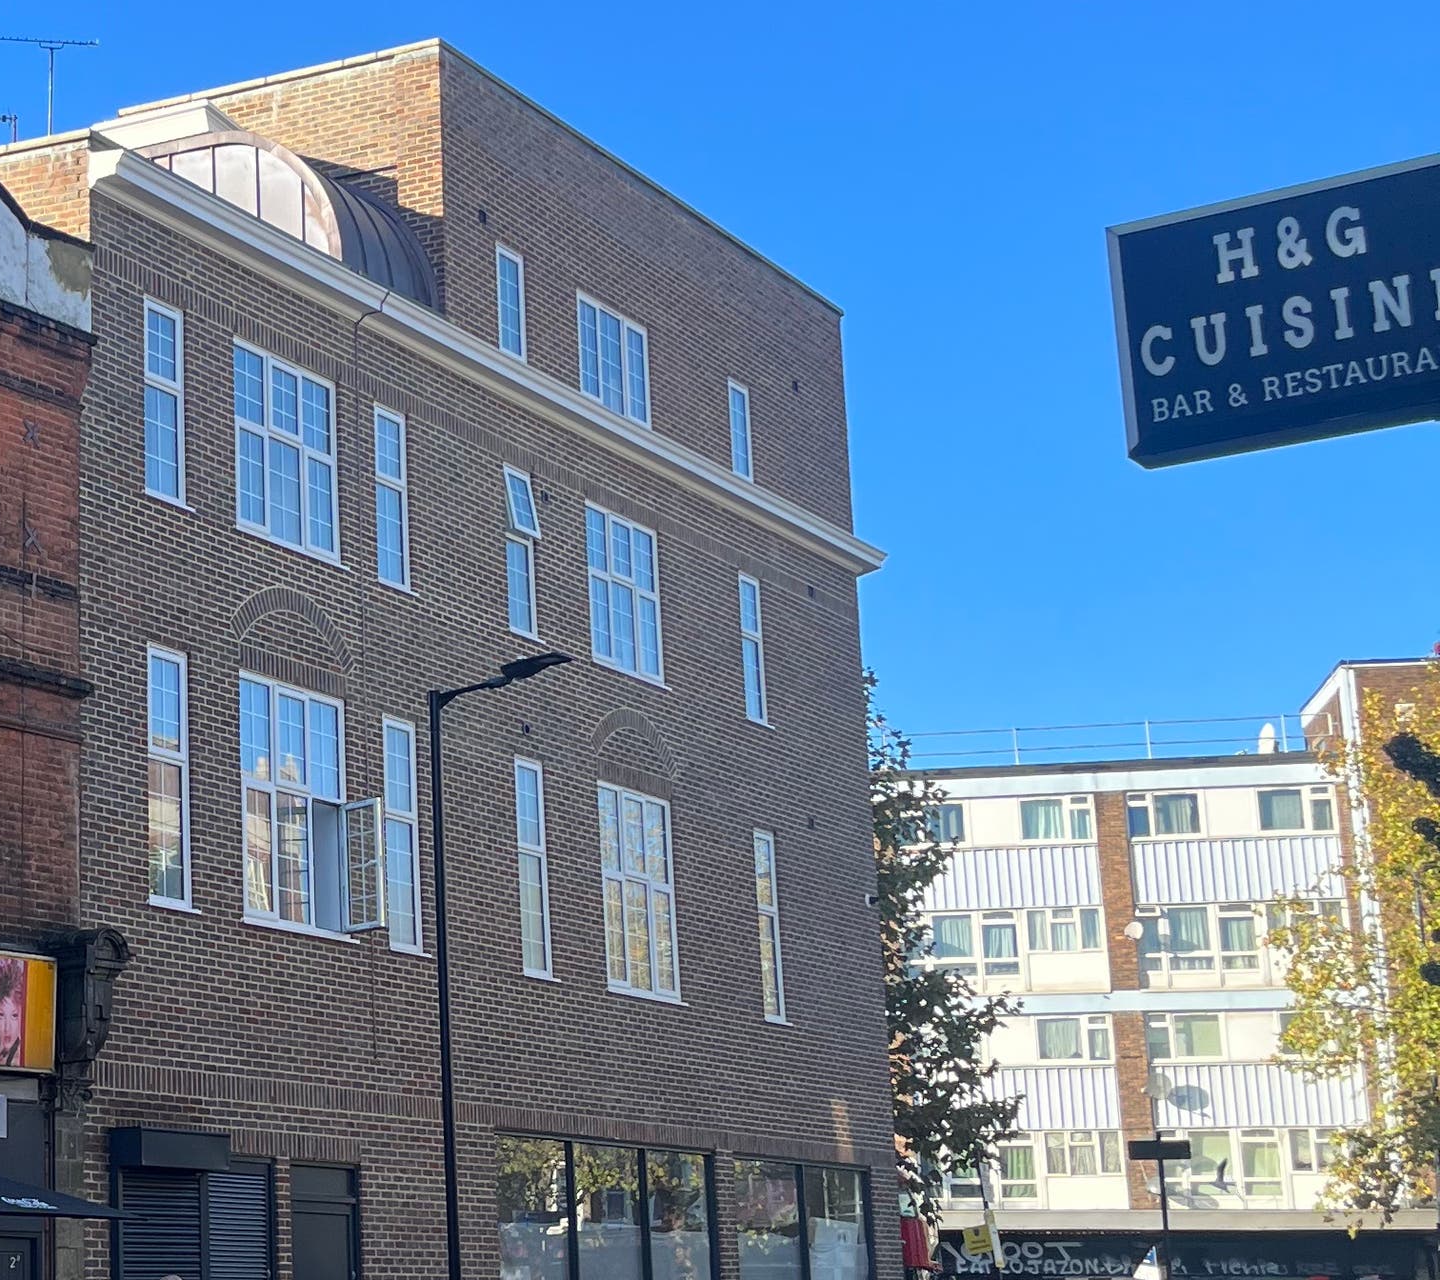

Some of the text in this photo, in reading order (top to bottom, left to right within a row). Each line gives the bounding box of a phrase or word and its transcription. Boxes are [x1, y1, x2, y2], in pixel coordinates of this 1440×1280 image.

[1152, 346, 1440, 422] BAR & RESTAURA
